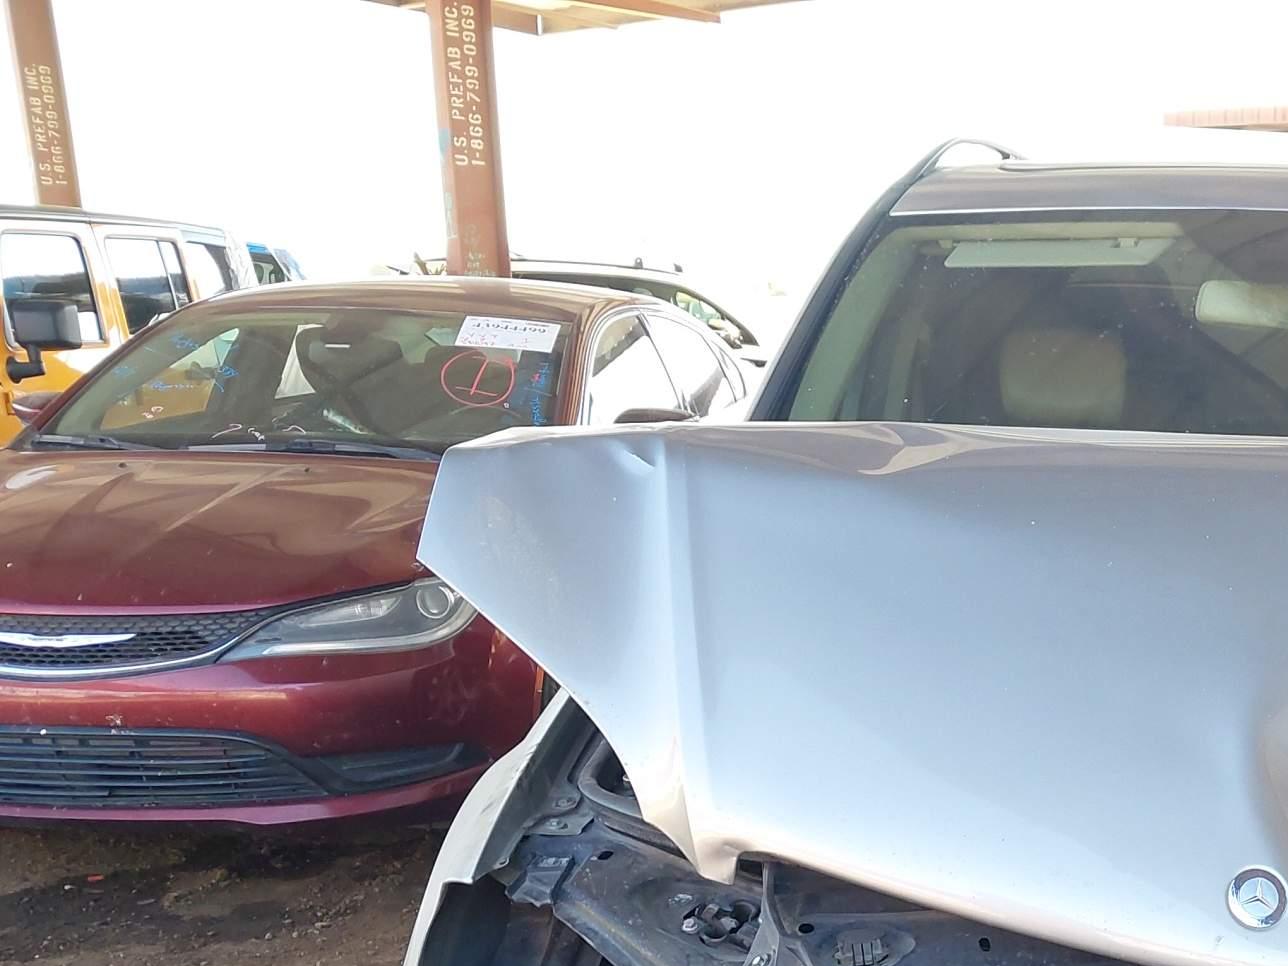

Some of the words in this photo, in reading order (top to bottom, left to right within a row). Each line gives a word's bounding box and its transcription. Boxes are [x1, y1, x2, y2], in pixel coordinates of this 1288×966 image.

[444, 2, 460, 36] INC.
[24, 64, 39, 89] INC.
[447, 46, 465, 120] PREFAB
[461, 4, 485, 165] 1-866-799-0969
[29, 97, 48, 151] PREFAB
[454, 131, 468, 165] U.S.
[40, 160, 53, 184] U.S.
